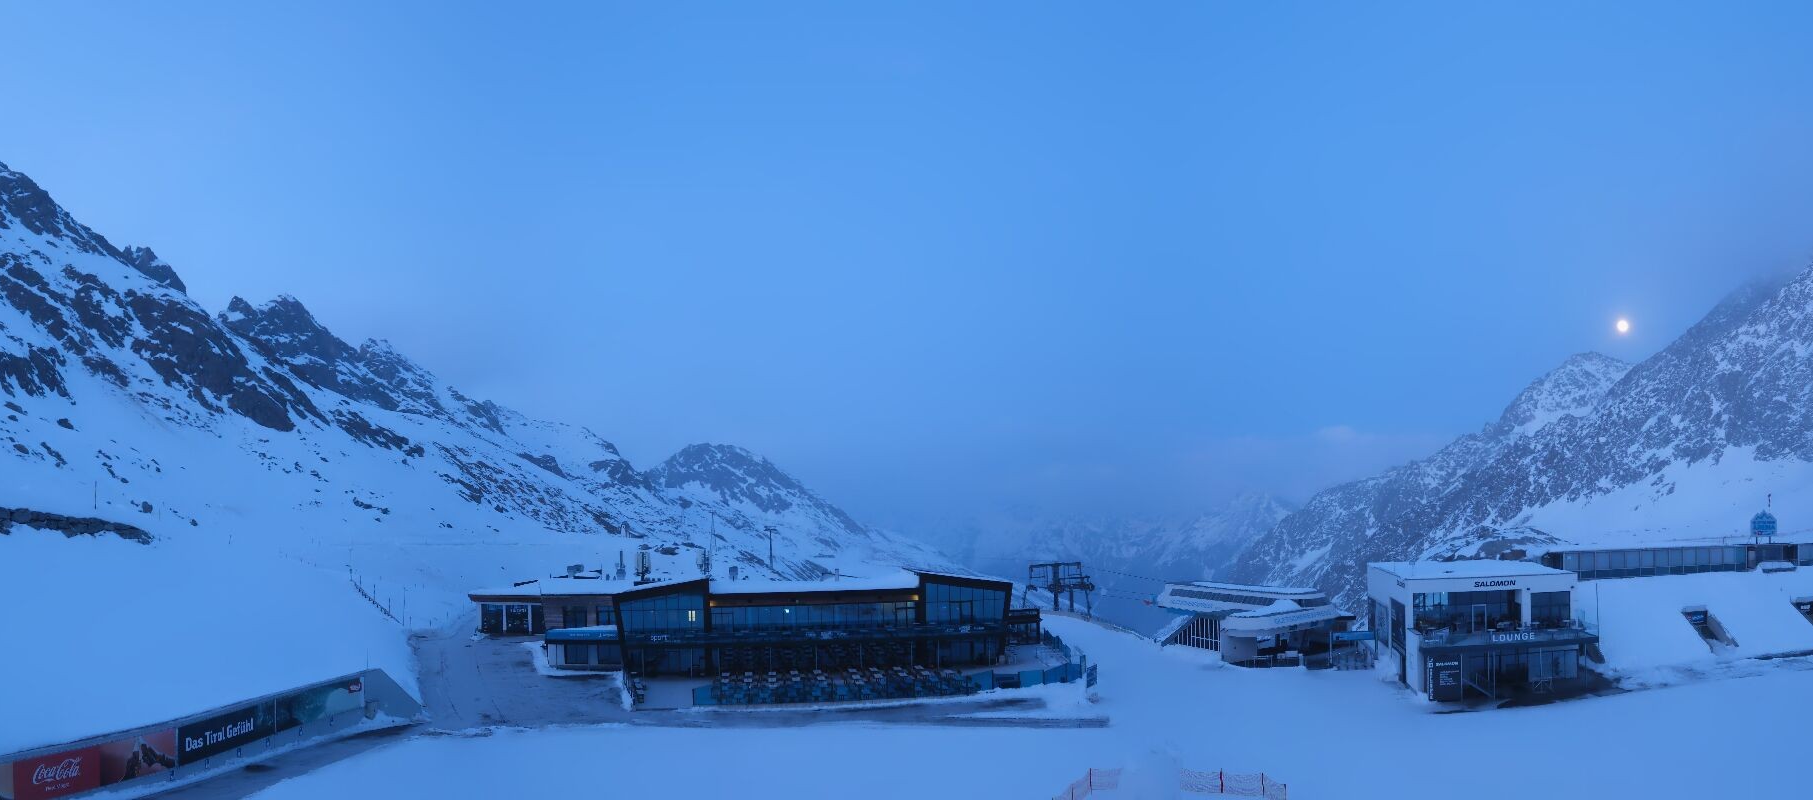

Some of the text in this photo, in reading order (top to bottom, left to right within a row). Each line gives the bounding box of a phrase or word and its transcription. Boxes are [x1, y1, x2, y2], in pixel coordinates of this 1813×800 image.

[1473, 579, 1517, 588] SALOMON
[1492, 632, 1536, 642] LOUNGE
[185, 717, 255, 752] Das Tirol Gefühl
[32, 756, 82, 785] Coca-Cola
